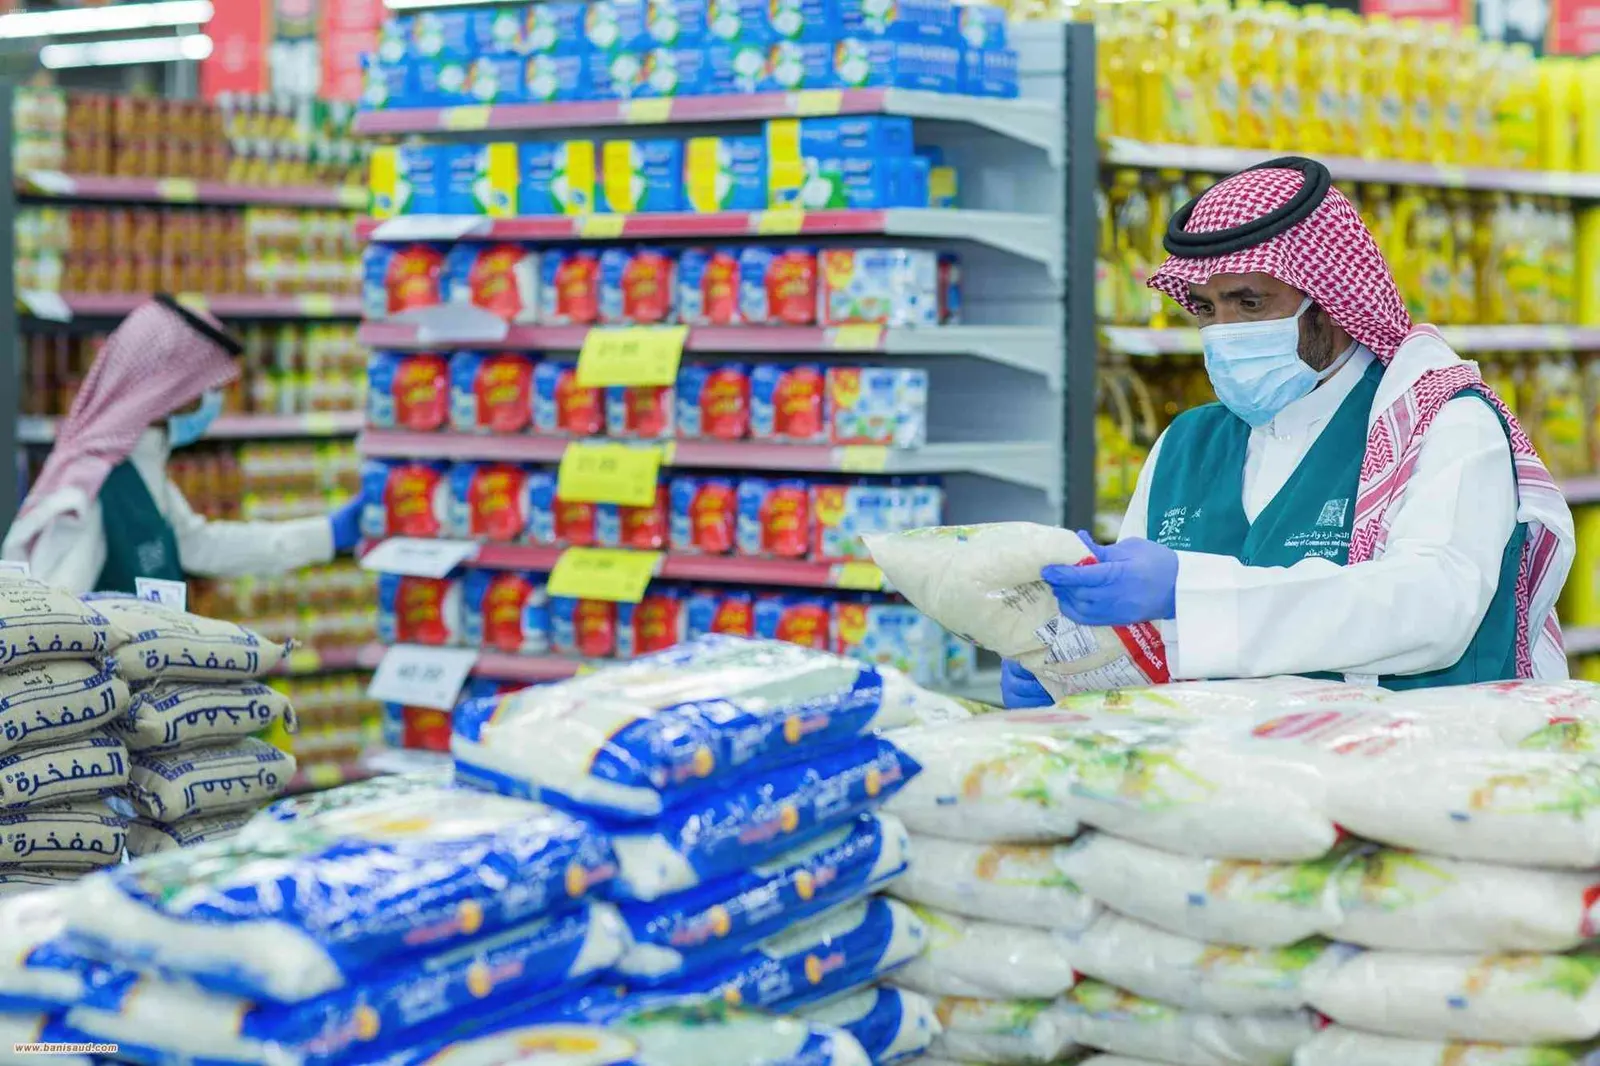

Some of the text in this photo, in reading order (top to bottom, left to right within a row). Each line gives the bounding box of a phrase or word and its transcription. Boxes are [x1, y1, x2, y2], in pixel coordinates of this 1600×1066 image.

[145, 647, 258, 674] المفخرة
[5, 687, 116, 742] المفخرة
[15, 752, 124, 797] المفخرة
[13, 831, 126, 859] المفخرة
